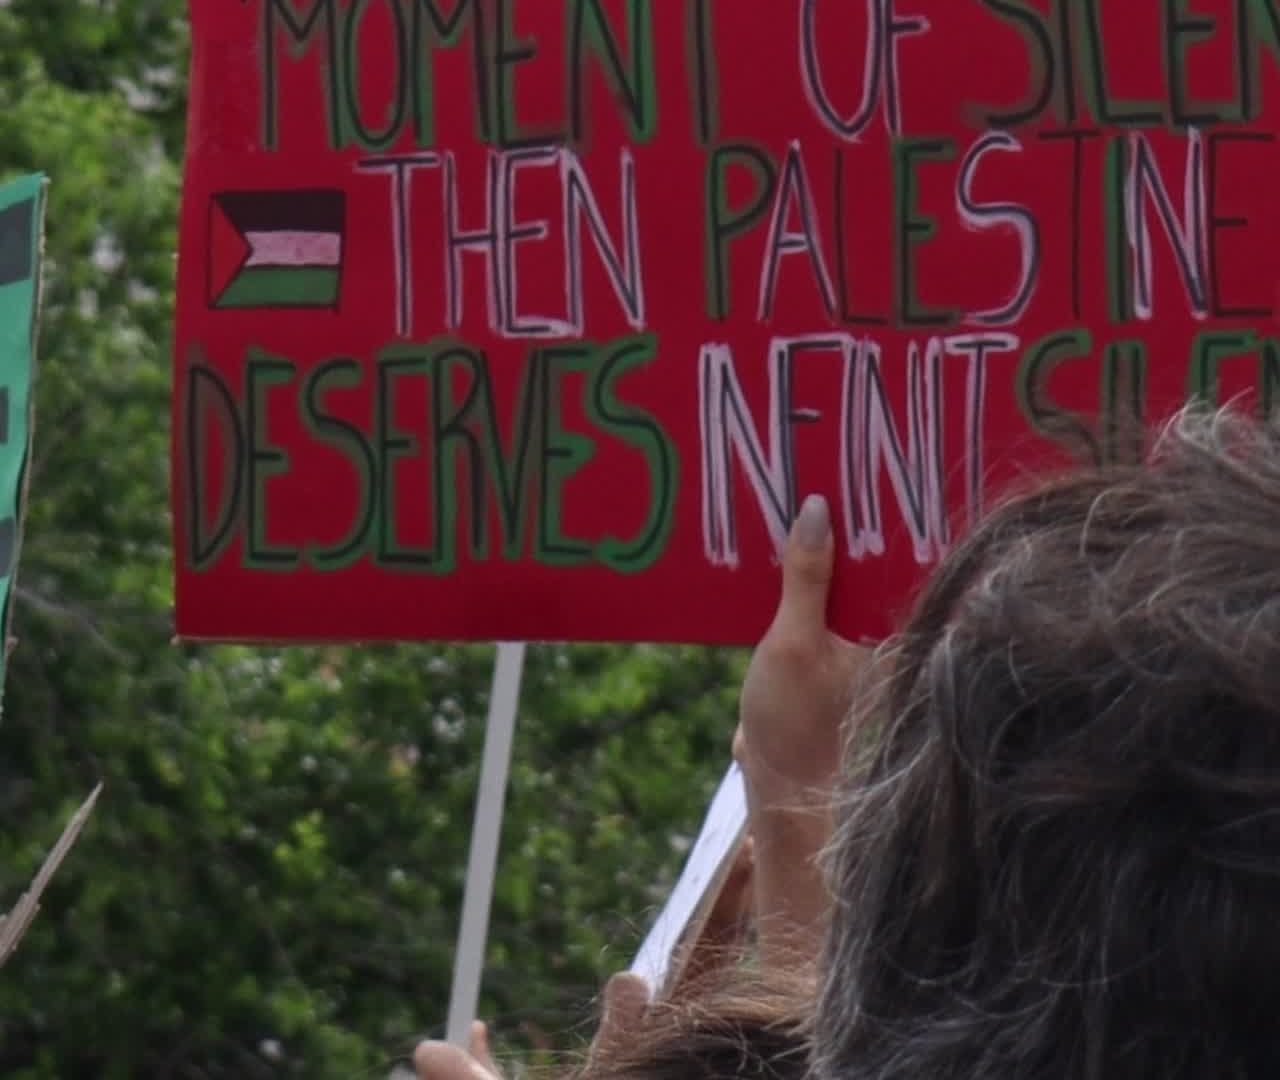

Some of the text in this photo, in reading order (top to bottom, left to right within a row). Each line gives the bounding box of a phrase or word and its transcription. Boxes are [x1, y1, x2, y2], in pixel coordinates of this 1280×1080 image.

[355, 125, 1276, 338] THEN PALESTINE
[177, 330, 680, 575] DESERVES
